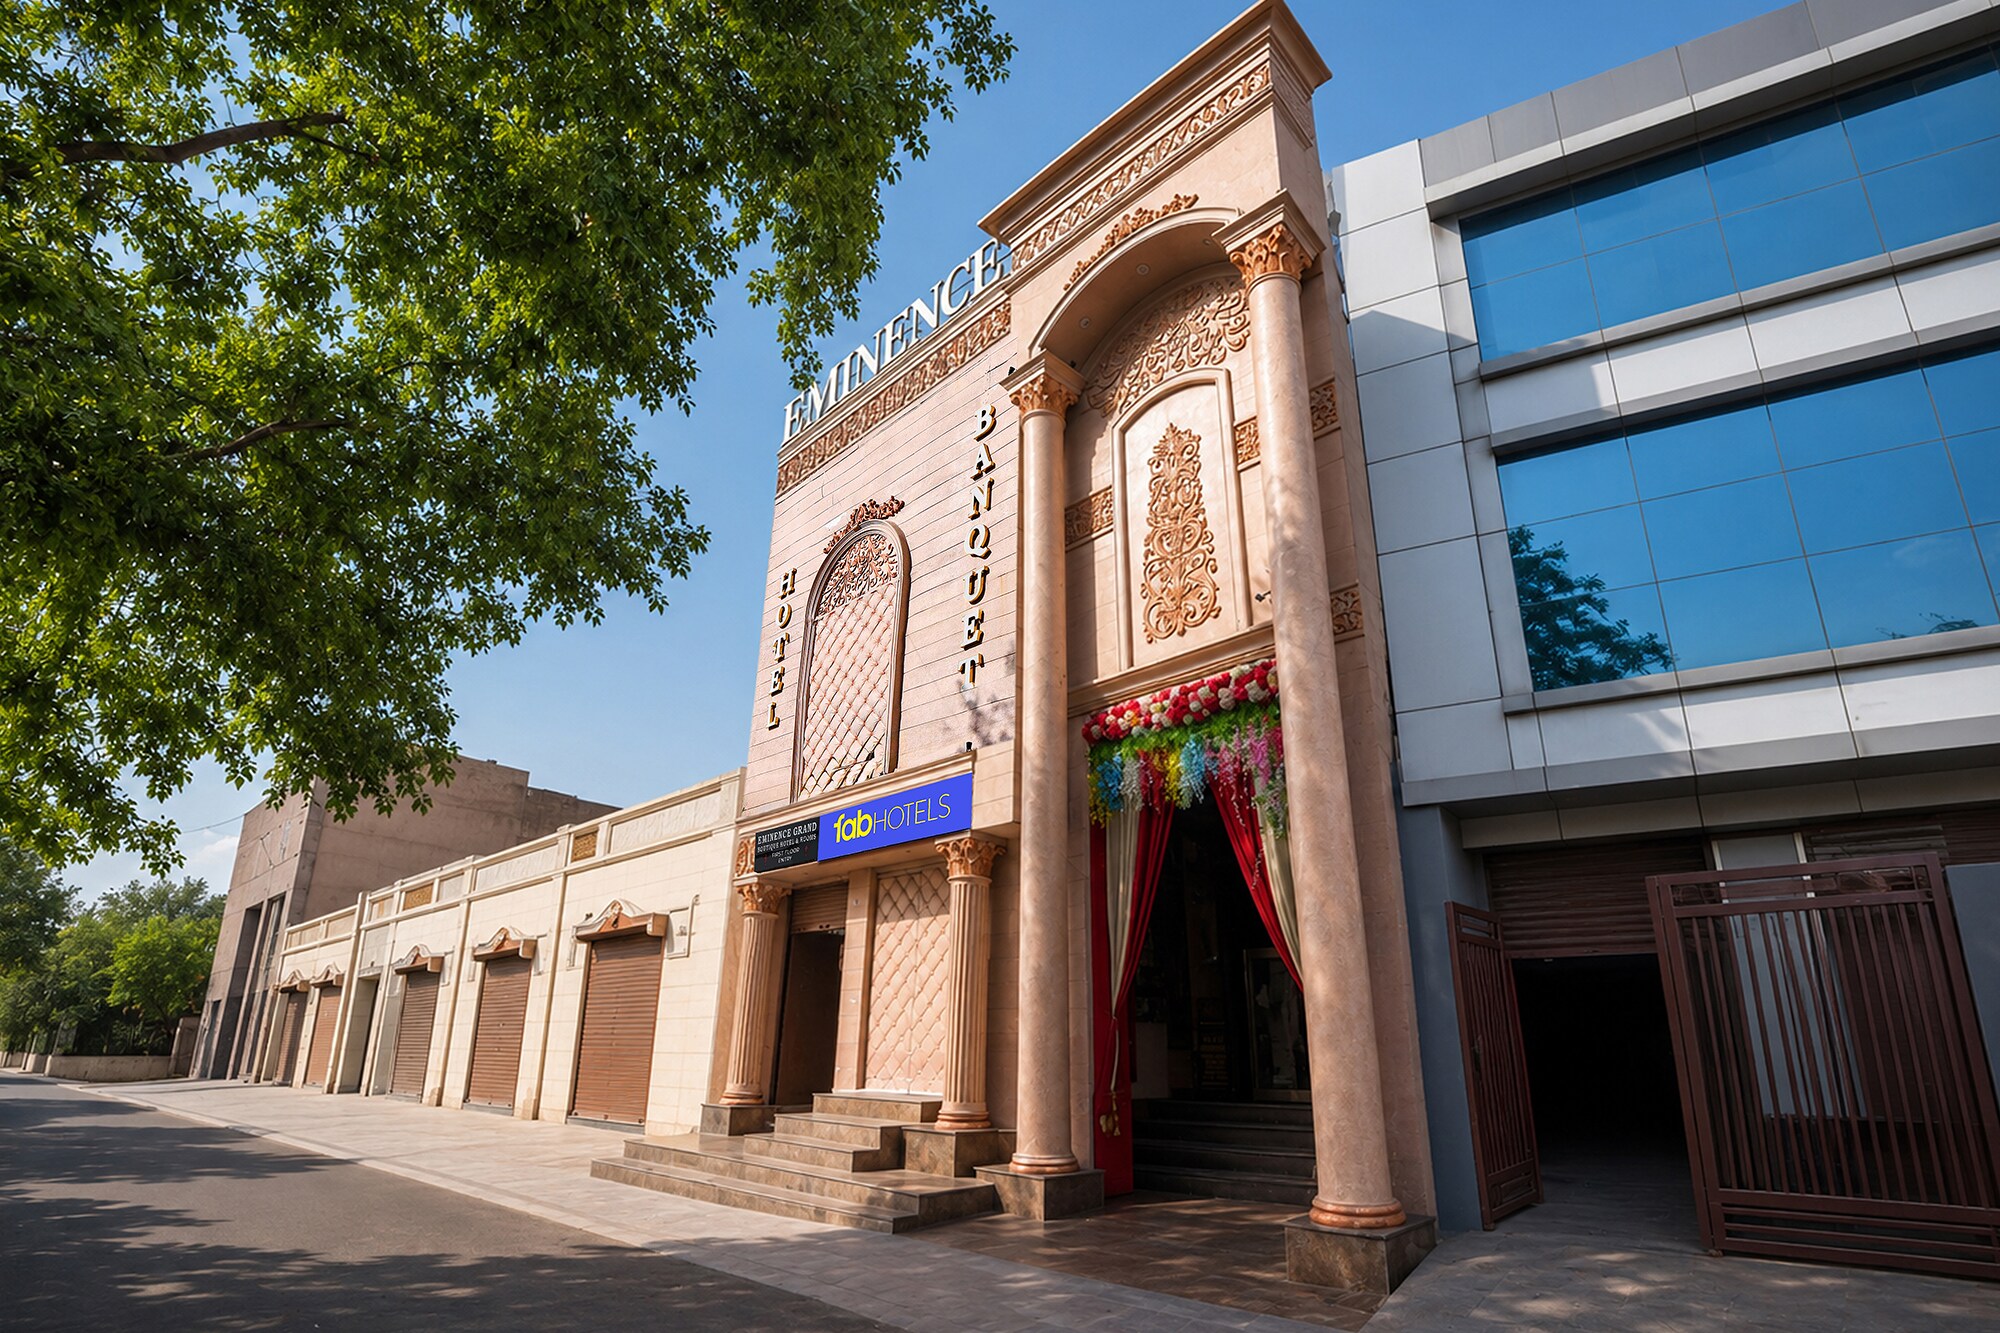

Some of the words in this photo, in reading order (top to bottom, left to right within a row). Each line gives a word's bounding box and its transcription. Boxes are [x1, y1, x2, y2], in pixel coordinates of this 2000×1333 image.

[782, 238, 1004, 443] EMINENCE
[958, 404, 997, 690] BANQUET
[767, 567, 797, 730] HOTEL
[757, 828, 792, 845] EMINENCE
[793, 822, 817, 836] GRAND
[757, 842, 779, 853] BOUTIQUE
[780, 838, 794, 848] HOTEL
[799, 833, 817, 843] ROOMS
[771, 850, 784, 858] FIRST
[777, 856, 792, 864] ENTRY
